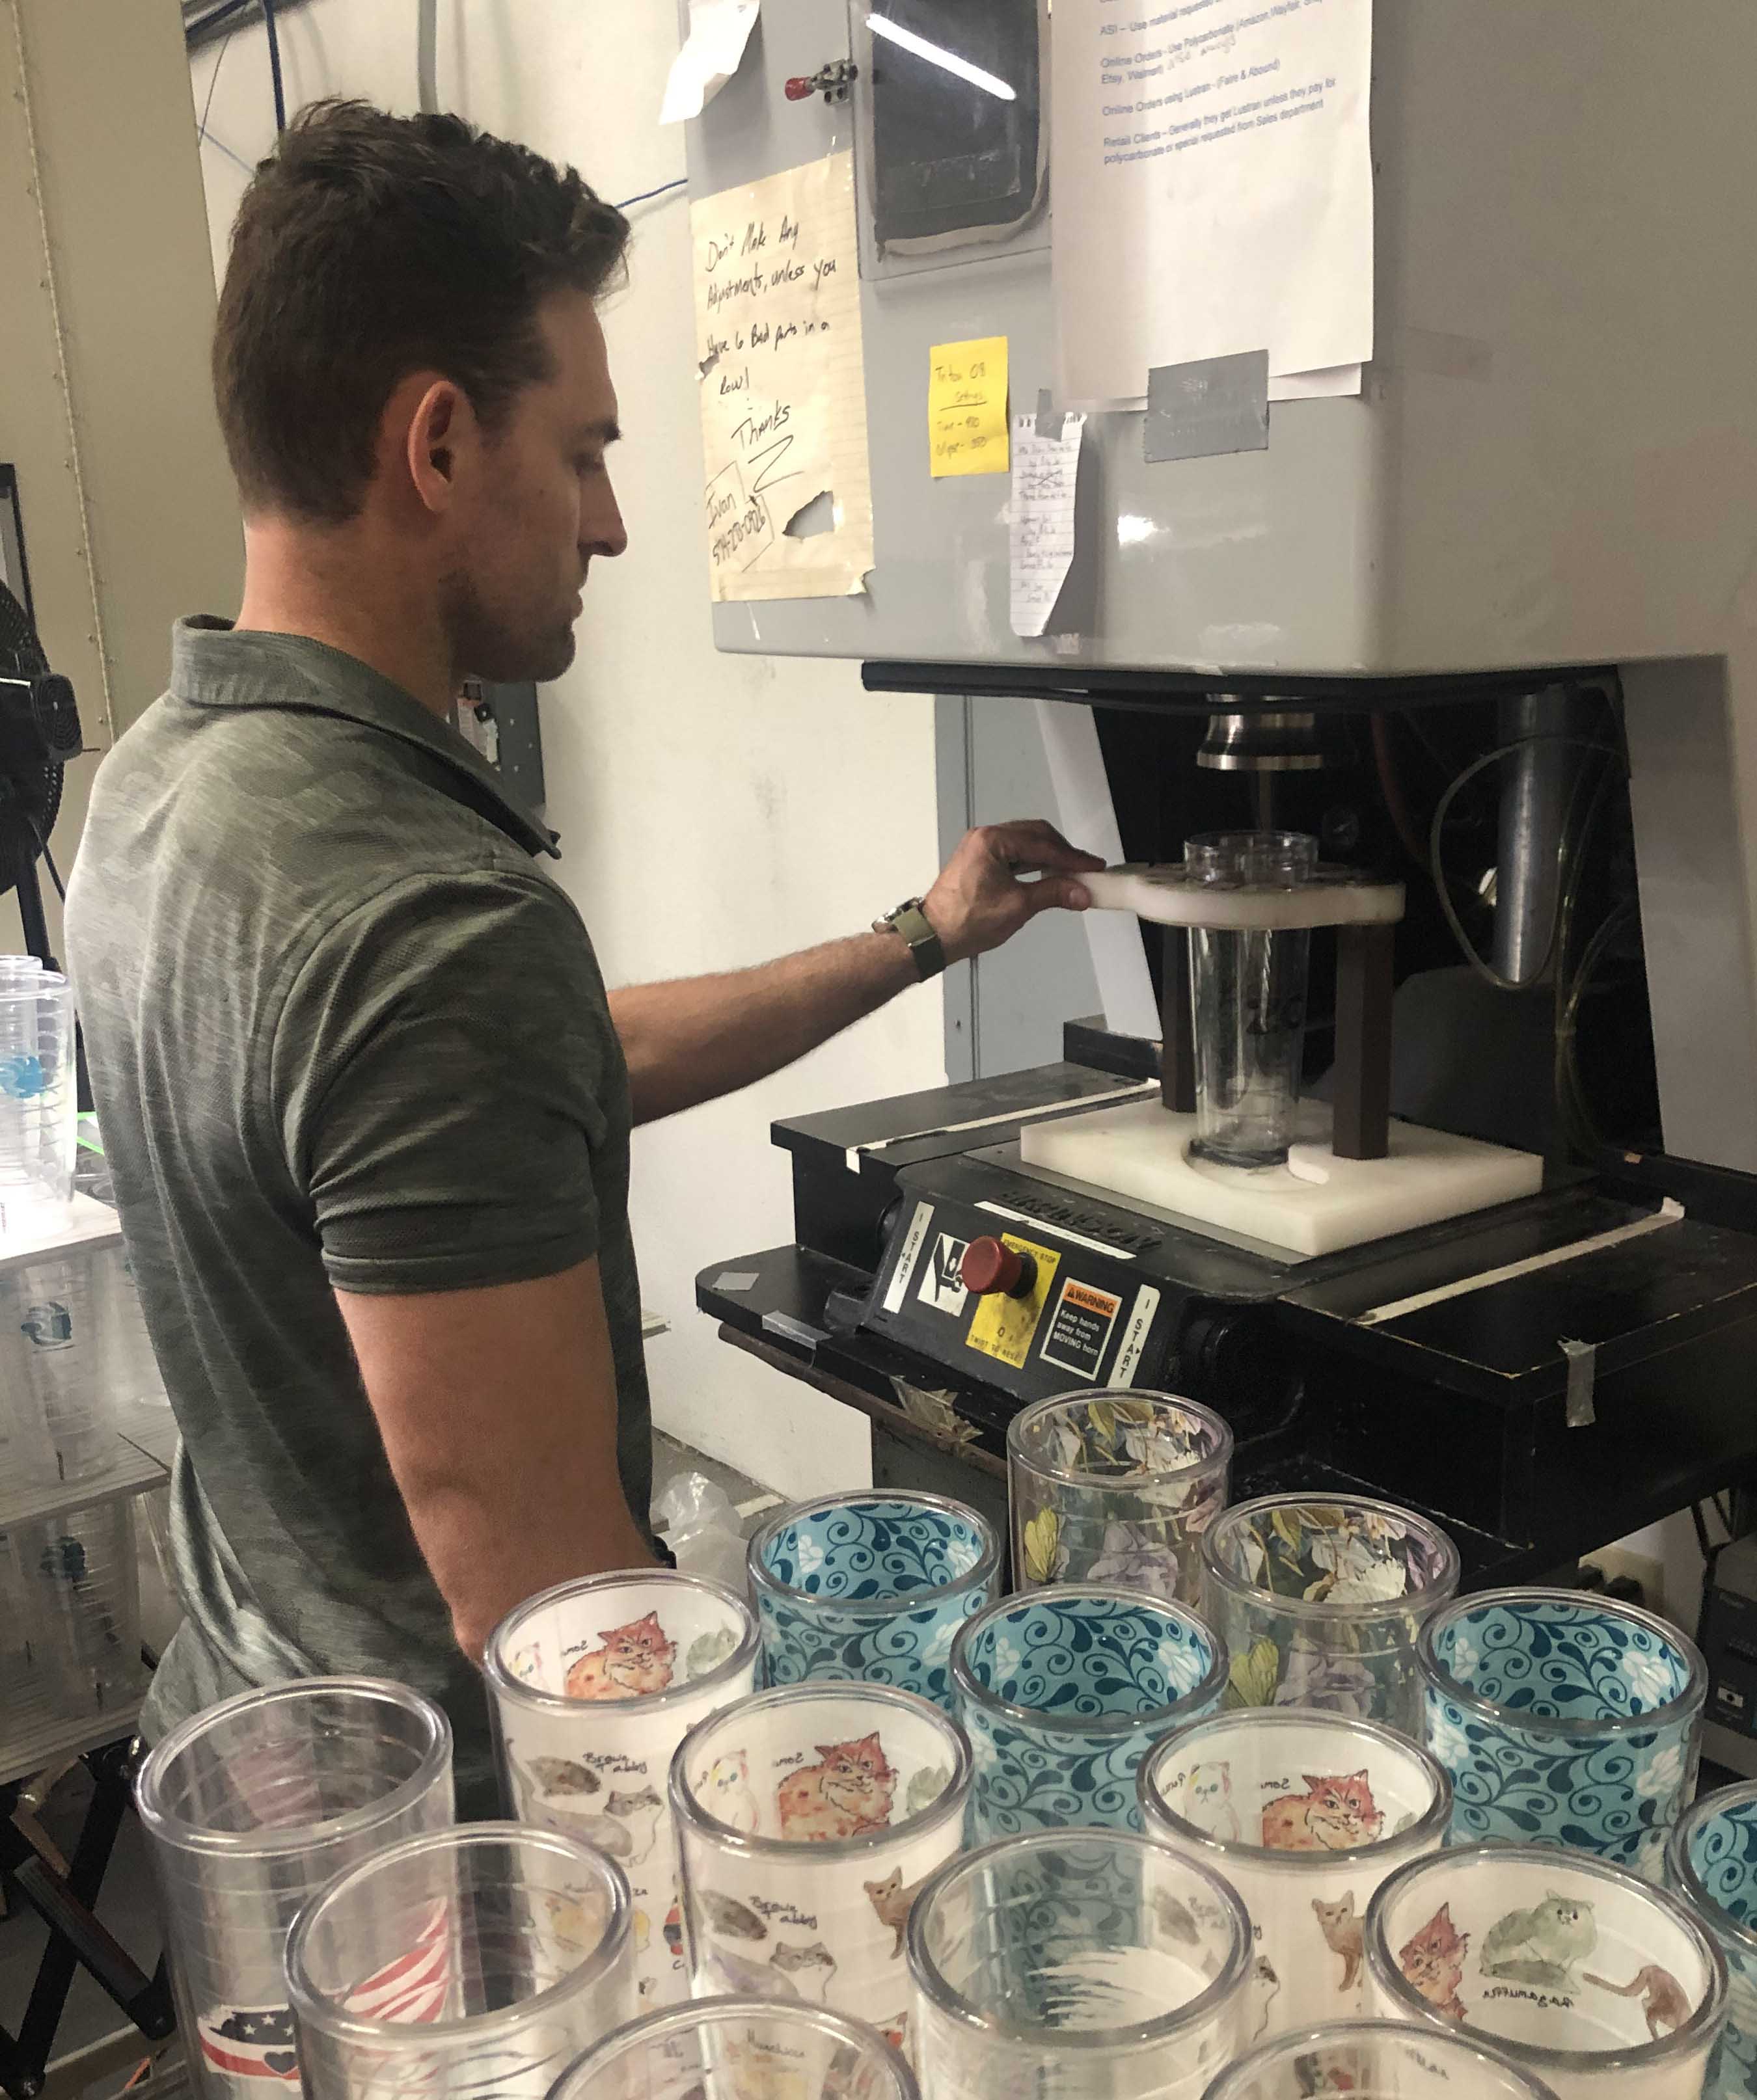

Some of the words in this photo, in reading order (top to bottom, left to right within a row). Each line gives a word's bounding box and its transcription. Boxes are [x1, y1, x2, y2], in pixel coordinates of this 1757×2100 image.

[1101, 57, 1132, 68] Online
[1102, 105, 1134, 116] Online
[1240, 69, 1246, 79] &
[741, 220, 767, 257] Make
[778, 213, 800, 250] Any
[770, 259, 806, 287] unless
[707, 333, 730, 356] Have
[751, 322, 770, 348] Bad
[802, 319, 815, 336] in
[730, 399, 791, 451] Thanks
[898, 1231, 920, 1284] START
[1040, 1252, 1057, 1263] STOP
[1074, 1290, 1115, 1314] WARNING
[1056, 1321, 1075, 1334] away
[1074, 1328, 1092, 1341] from
[1059, 1309, 1078, 1323] Keep
[1078, 1314, 1101, 1332] hands
[1052, 1331, 1082, 1349] MOVING
[1082, 1344, 1099, 1356] horn
[1119, 1318, 1143, 1379] START
[748, 1896, 798, 1913] Brown
